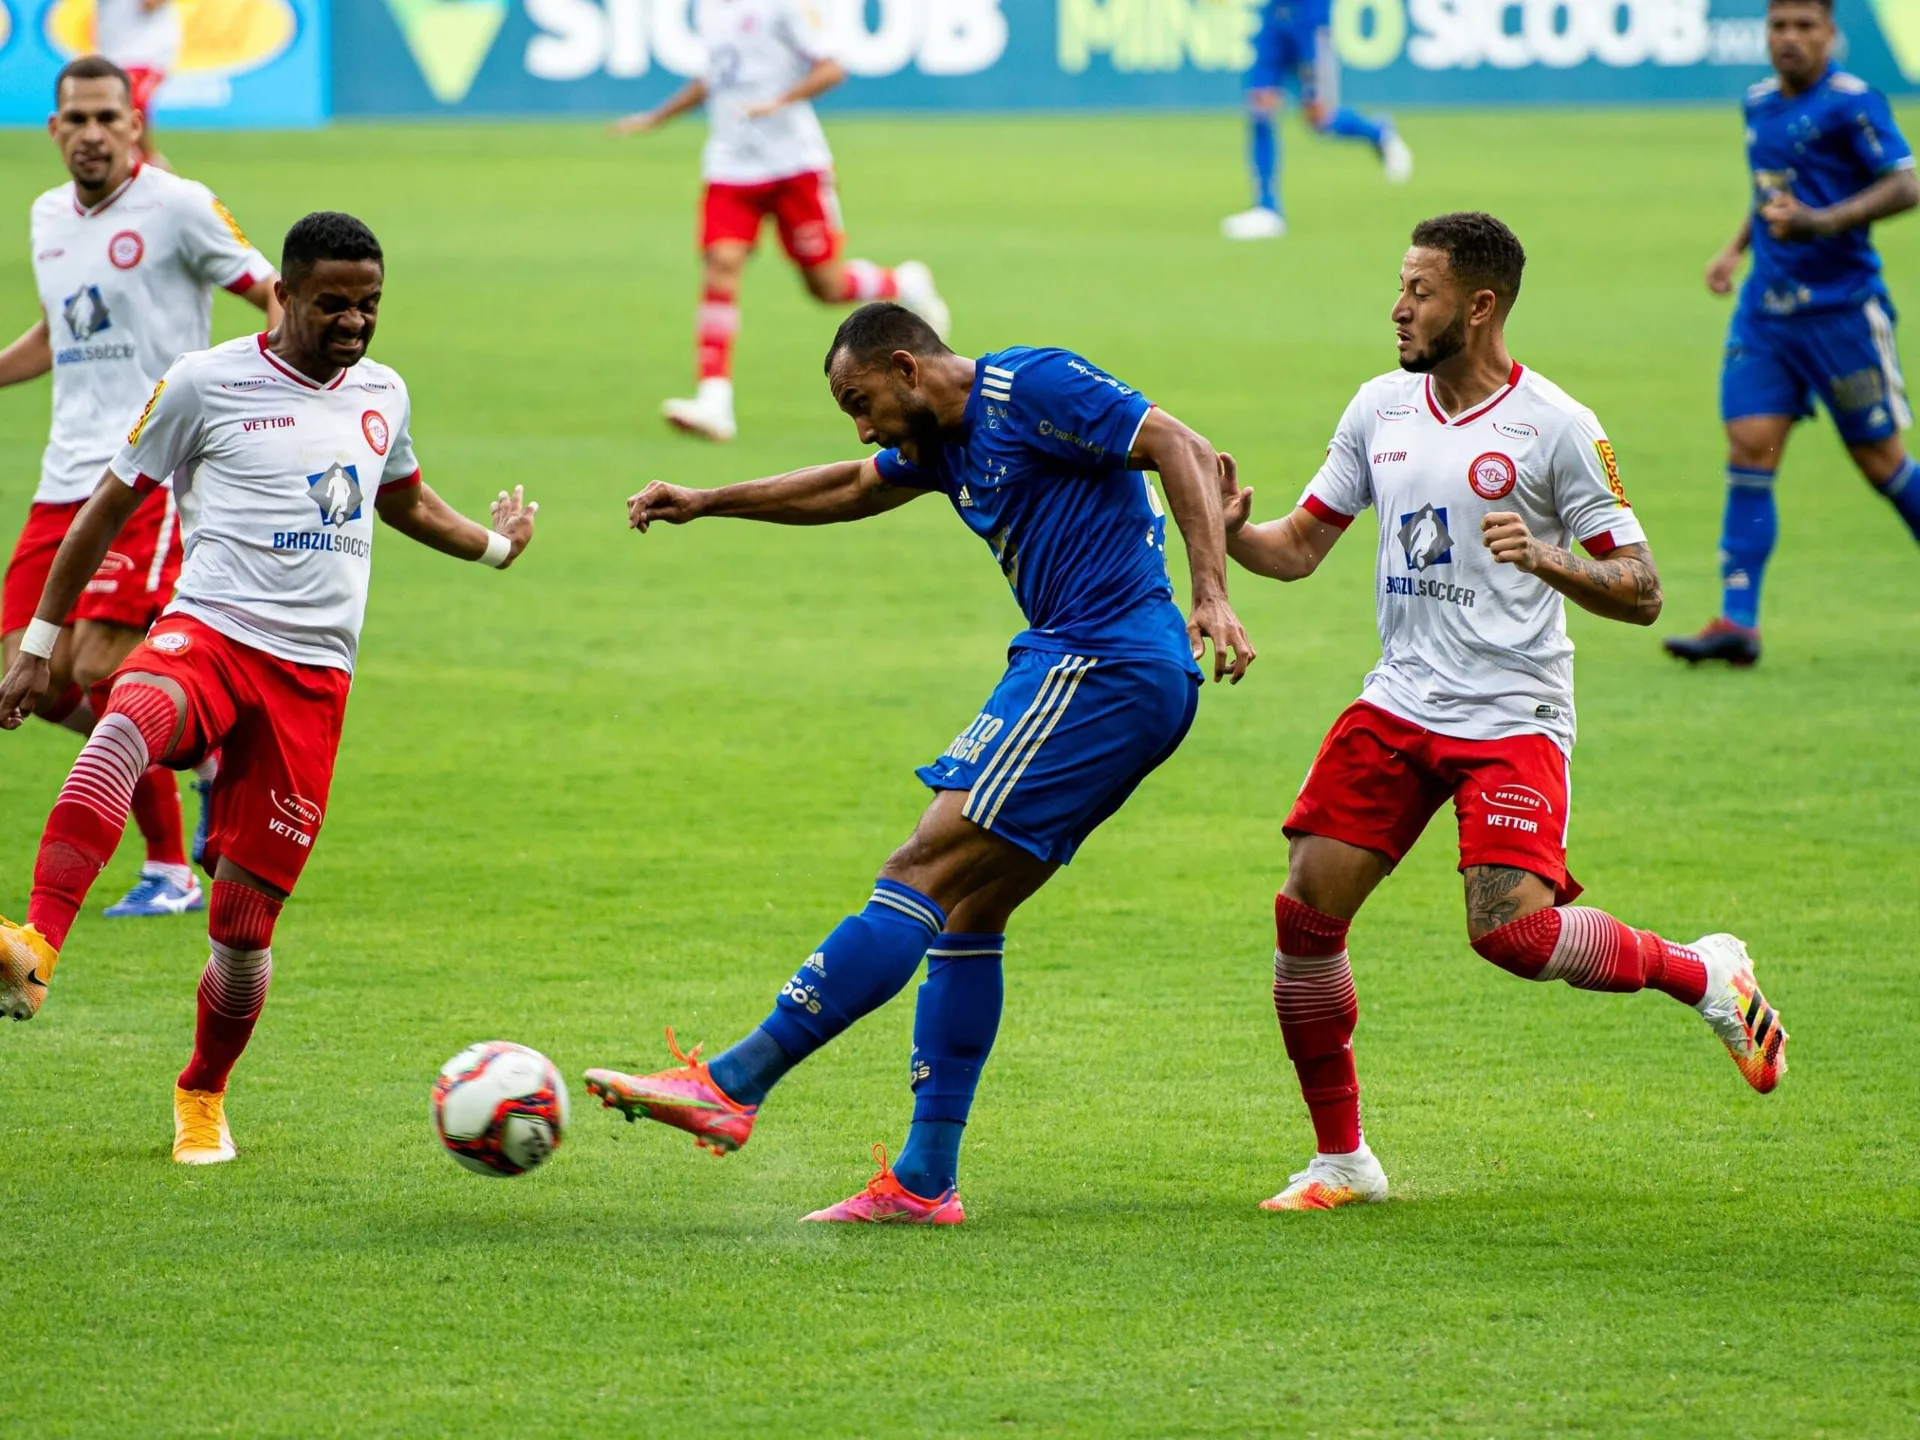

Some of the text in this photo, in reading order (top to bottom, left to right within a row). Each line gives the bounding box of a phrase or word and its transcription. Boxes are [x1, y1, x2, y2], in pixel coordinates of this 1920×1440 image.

[523, 0, 1009, 80] SICOB
[1056, 0, 1405, 73] MINEO
[1406, 0, 1706, 69] SICOOB
[243, 416, 296, 432] VETTOR
[1373, 451, 1408, 464] VETTOR
[1495, 791, 1541, 808] PHYSICUS
[268, 817, 311, 848] VETTOR
[1487, 813, 1538, 833] VETTOR
